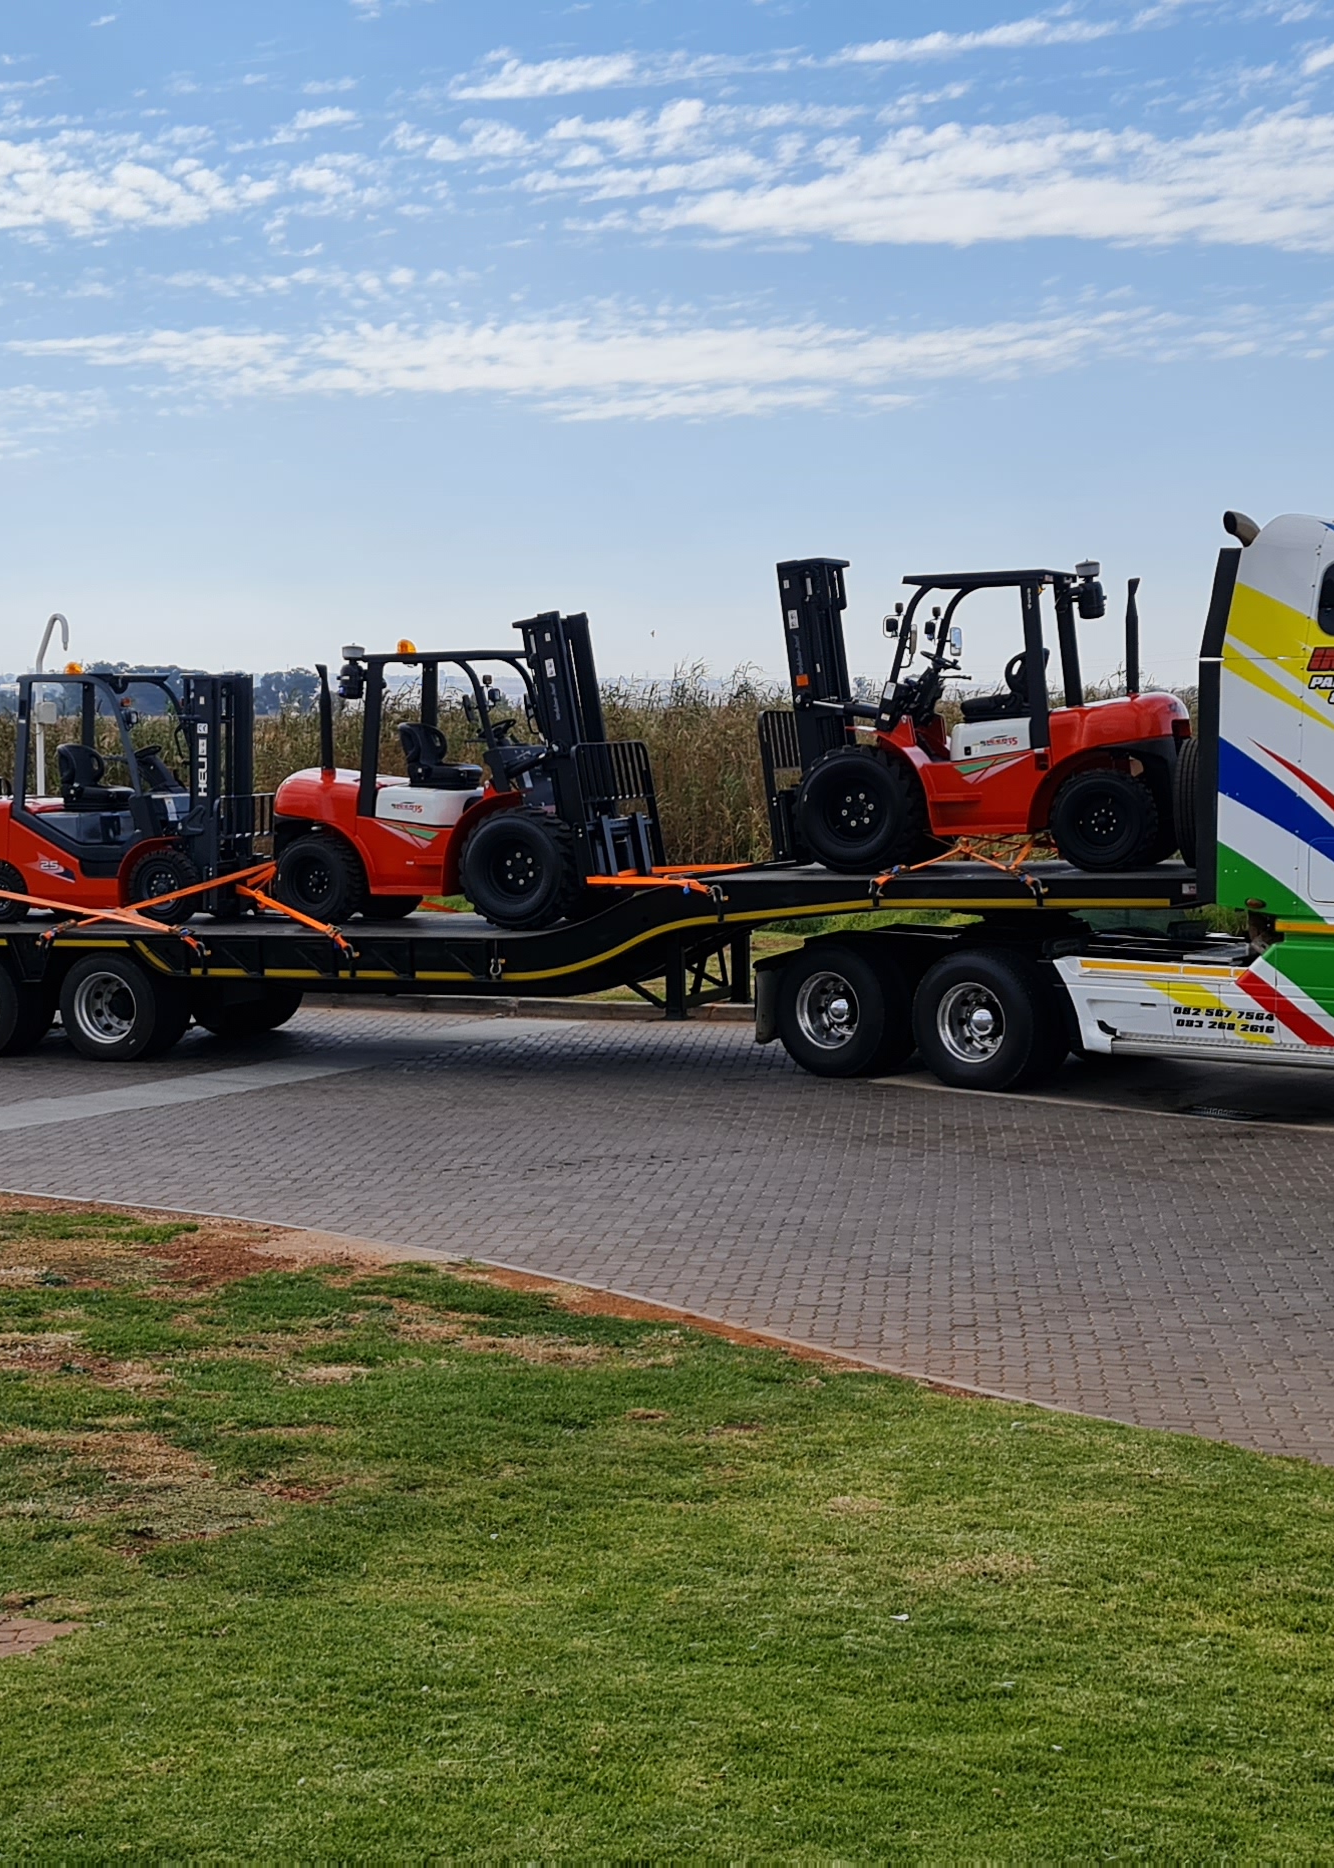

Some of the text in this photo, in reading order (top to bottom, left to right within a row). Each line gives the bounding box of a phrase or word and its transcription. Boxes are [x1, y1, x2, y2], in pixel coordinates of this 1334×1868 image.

[40, 860, 59, 870] 25
[1173, 1006, 1201, 1016] 082
[1176, 1019, 1204, 1028] 083
